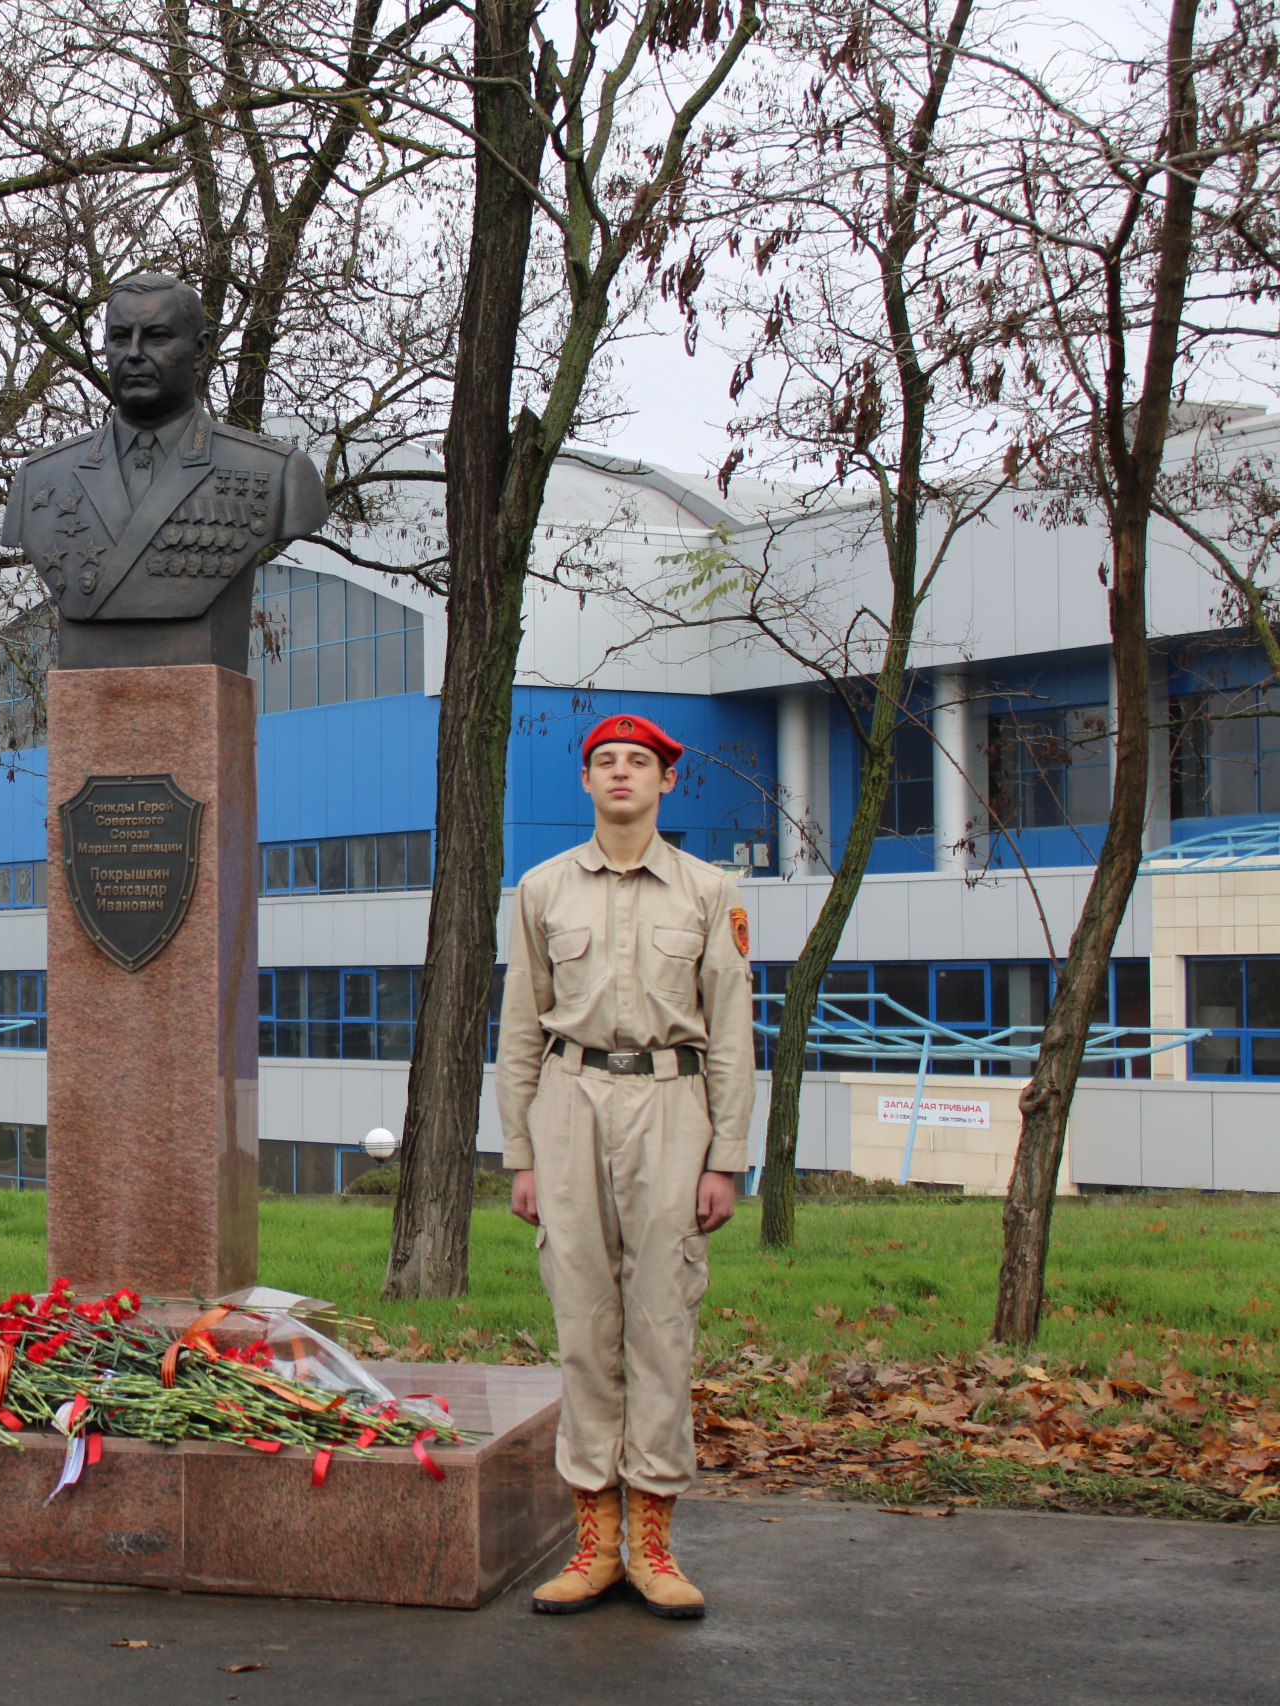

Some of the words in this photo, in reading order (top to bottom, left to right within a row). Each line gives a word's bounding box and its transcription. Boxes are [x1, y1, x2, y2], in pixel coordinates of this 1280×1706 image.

[87, 801, 134, 814] Трижды
[138, 800, 175, 814] Герой
[95, 815, 165, 826] Советского
[110, 829, 150, 840] Союза
[77, 842, 127, 855] Маршал
[131, 843, 183, 854] авиации
[90, 867, 170, 883] Покрышкин
[93, 883, 167, 898] Александр
[96, 898, 164, 912] Иванович
[938, 1103, 982, 1113] ТРИБУНА
